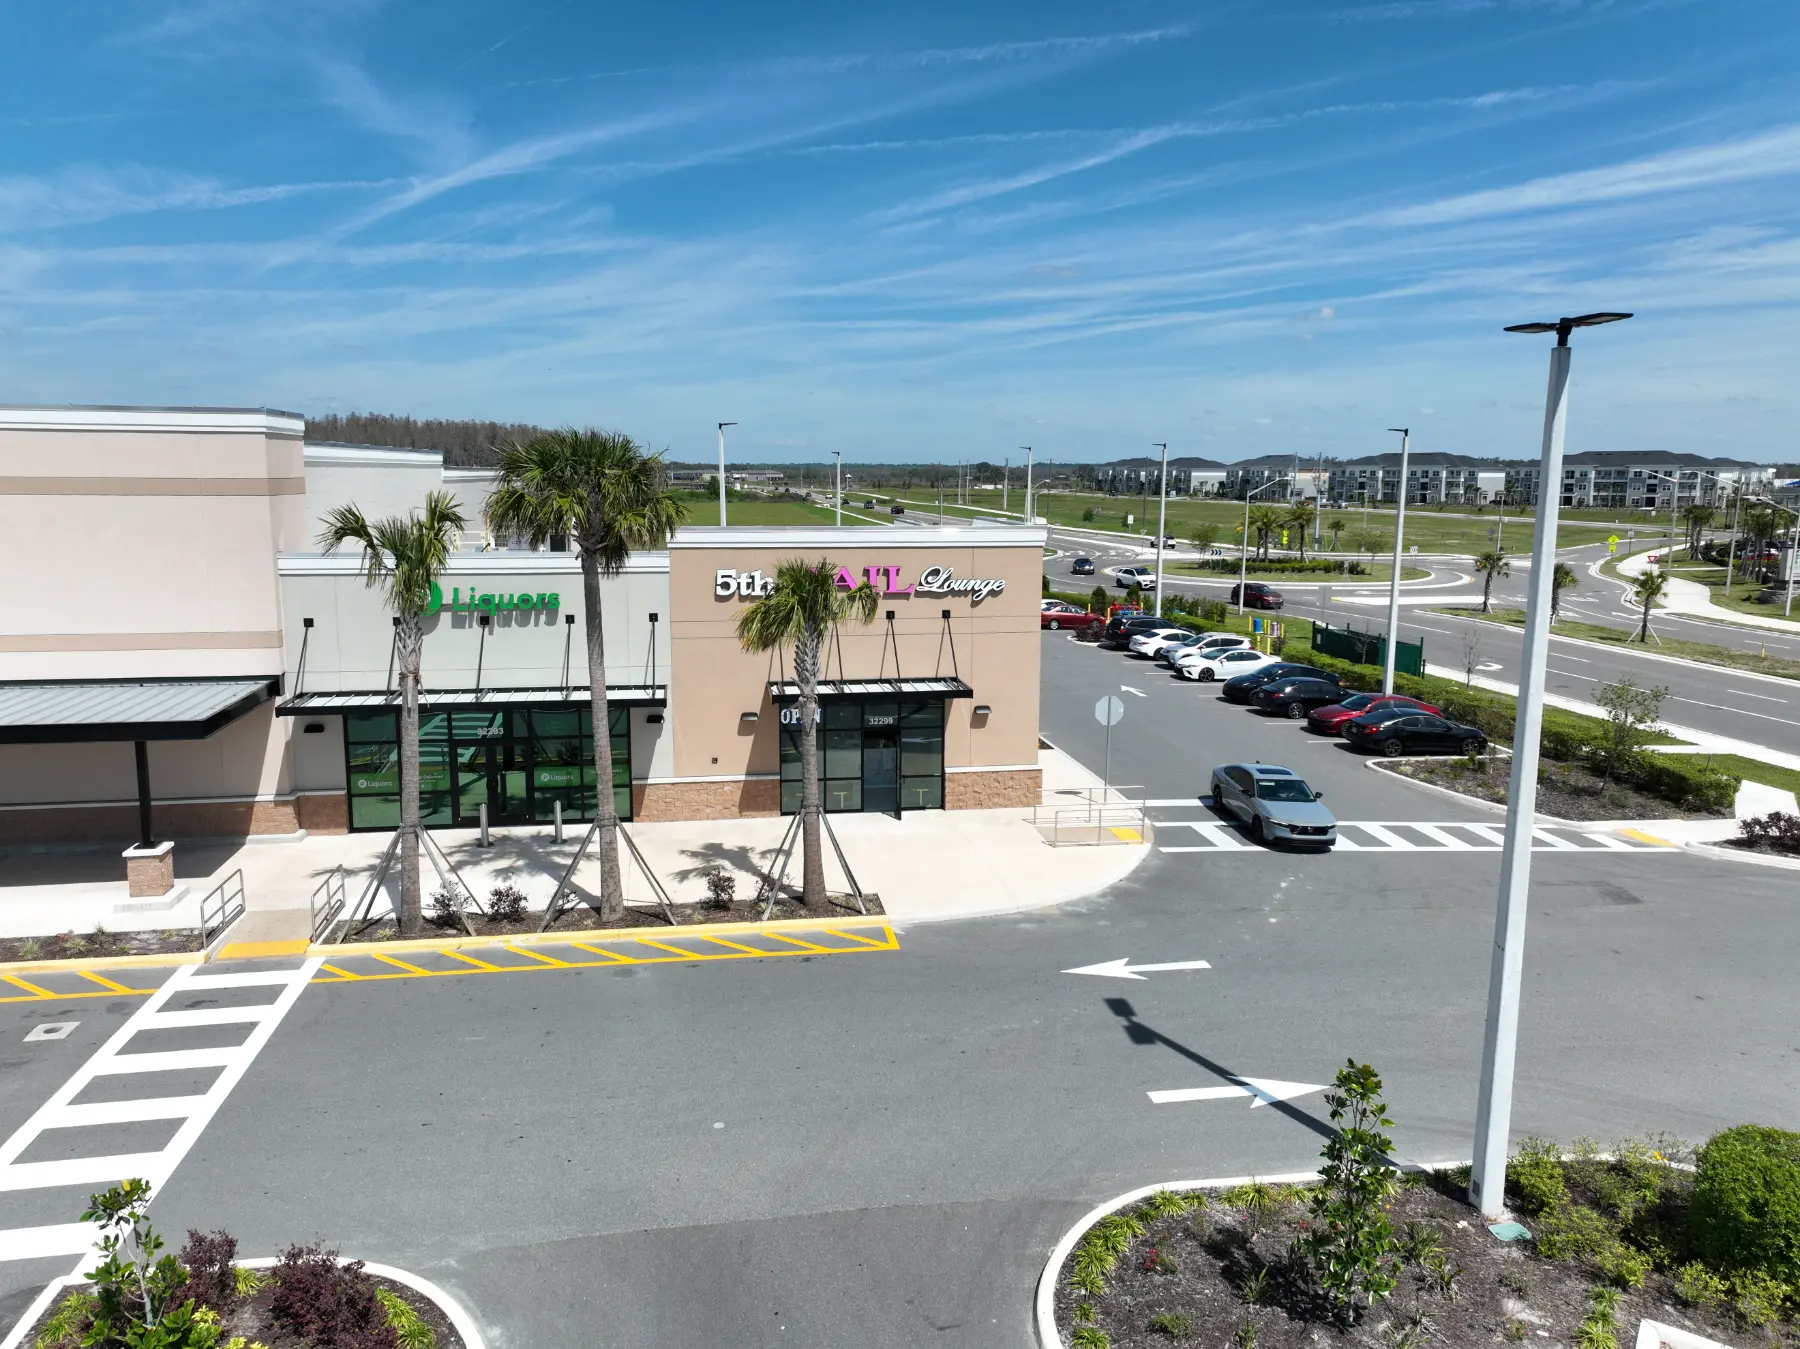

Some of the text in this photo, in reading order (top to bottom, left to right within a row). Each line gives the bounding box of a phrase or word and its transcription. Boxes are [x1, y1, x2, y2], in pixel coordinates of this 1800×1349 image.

[715, 565, 1006, 601] 5th AIL Lounge
[452, 586, 560, 616] Liquors
[780, 708, 821, 724] OPN
[868, 717, 894, 725] 32299
[477, 727, 504, 735] 32293
[550, 773, 574, 781] Liquors
[367, 780, 393, 788] Liquors
